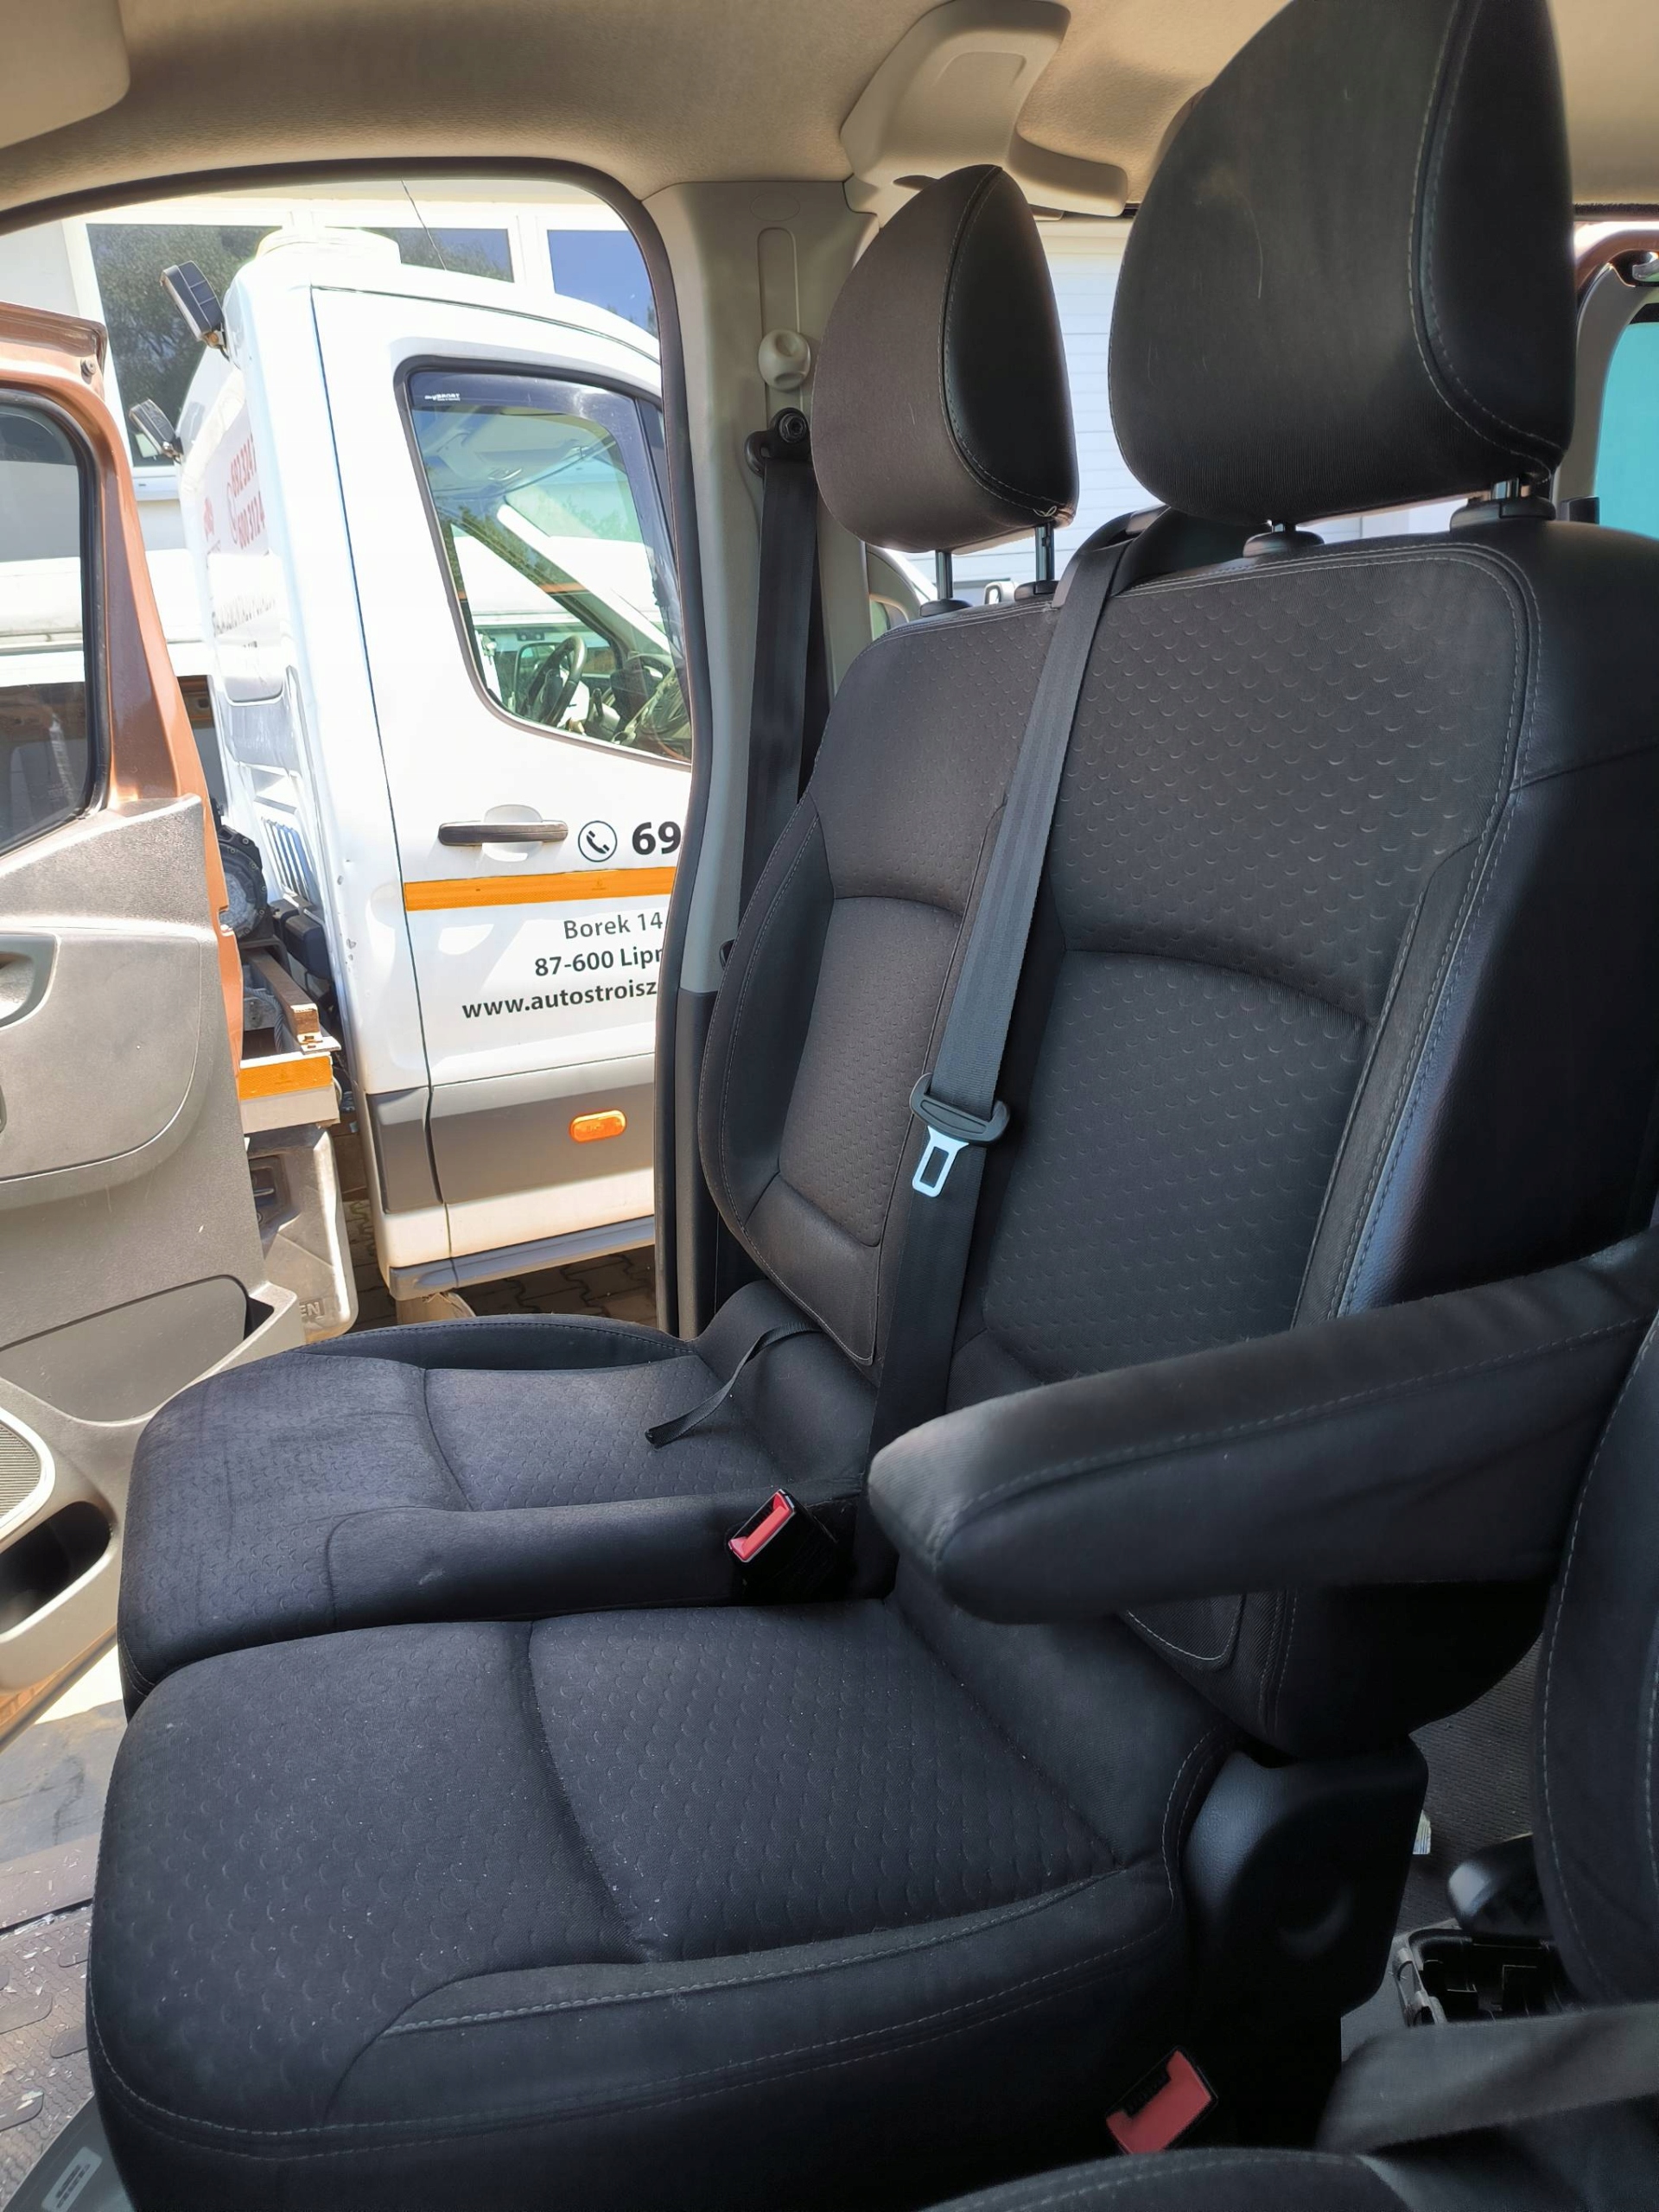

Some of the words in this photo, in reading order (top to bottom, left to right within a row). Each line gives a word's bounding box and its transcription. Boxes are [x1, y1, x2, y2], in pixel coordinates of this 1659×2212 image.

[632, 821, 682, 855] 69
[563, 914, 632, 939] Borek
[535, 950, 614, 976] 87-600
[462, 979, 658, 1019] www.autostroisz
